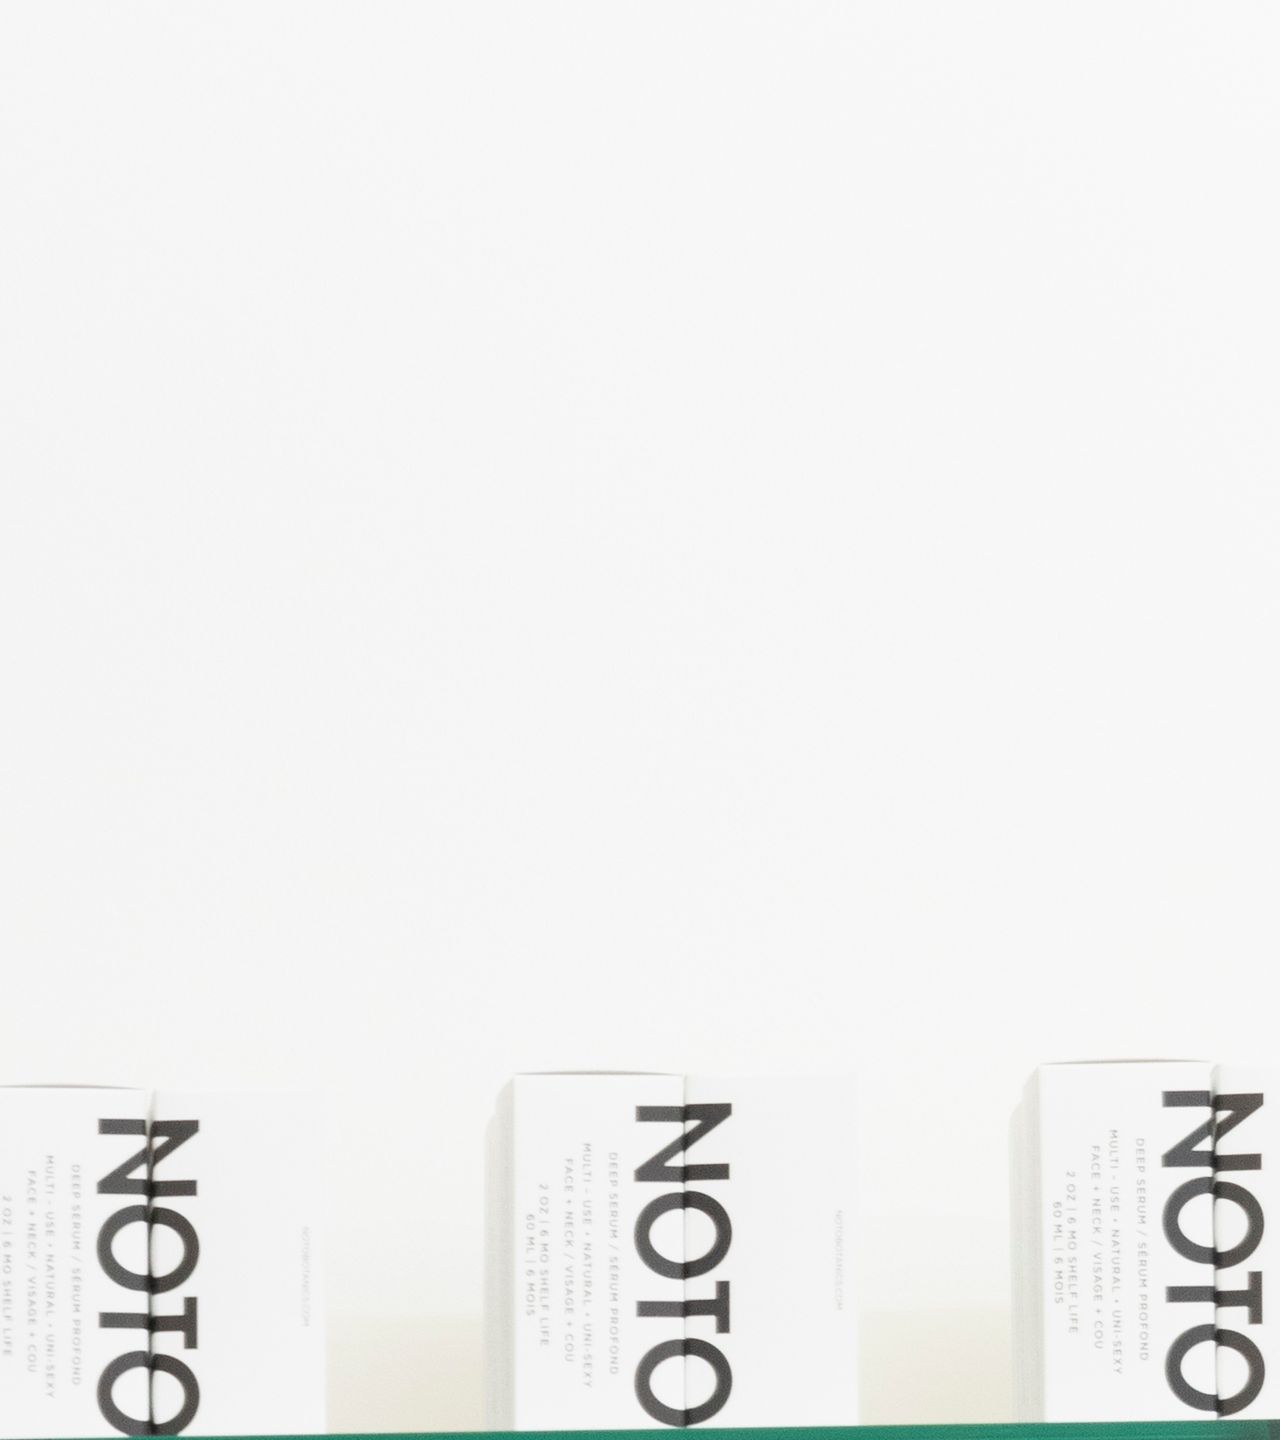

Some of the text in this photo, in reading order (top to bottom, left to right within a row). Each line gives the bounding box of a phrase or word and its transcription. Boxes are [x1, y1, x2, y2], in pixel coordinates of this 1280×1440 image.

[609, 1152, 618, 1187] DEEP
[1136, 1138, 1146, 1173] DEEP
[72, 1164, 81, 1200] DEEP
[1066, 1183, 1076, 1201] OZ
[1136, 1178, 1146, 1225] SERUM
[2, 1207, 12, 1226] OZ
[526, 1213, 535, 1231] 60
[539, 1196, 549, 1215] OZ
[609, 1193, 618, 1239] SERUM
[1053, 1201, 1062, 1218] 60
[72, 1204, 81, 1250] SERUM
[526, 1236, 535, 1254] ML
[1054, 1224, 1063, 1241] ML
[1068, 1230, 1077, 1251] MO
[3, 1254, 12, 1275] MO
[540, 1242, 549, 1263] MO
[564, 1158, 574, 1362] FACE NECK VISAGE COU
[582, 1142, 592, 1388] MULTI USE NATURAL UNI-SEXY
[634, 1103, 733, 1429] NOTO
[1091, 1145, 1104, 1349] FACE NECK VISAGE COU
[1109, 1129, 1122, 1375] MULTI USE NATURAL UNI-SEXY
[1161, 1090, 1266, 1418] NOTO
[27, 1170, 37, 1373] FACE NECK VISAGE COU
[45, 1155, 55, 1398] MULTI USE NATURAL UNI-SEXY
[97, 1119, 200, 1437] NOTO
[539, 1269, 549, 1311] SHELF
[1054, 1270, 1064, 1304] MOIS
[1068, 1256, 1078, 1299] SHELF
[2, 1280, 12, 1322] SHELF
[526, 1282, 535, 1316] MOIS
[1068, 1304, 1079, 1333] LIFE
[3, 1327, 12, 1356] LIFE
[540, 1317, 550, 1346] LIFE
[609, 1307, 619, 1375] PROFOND
[1139, 1293, 1149, 1361] PROFOND
[71, 1318, 82, 1386] PROFOND
